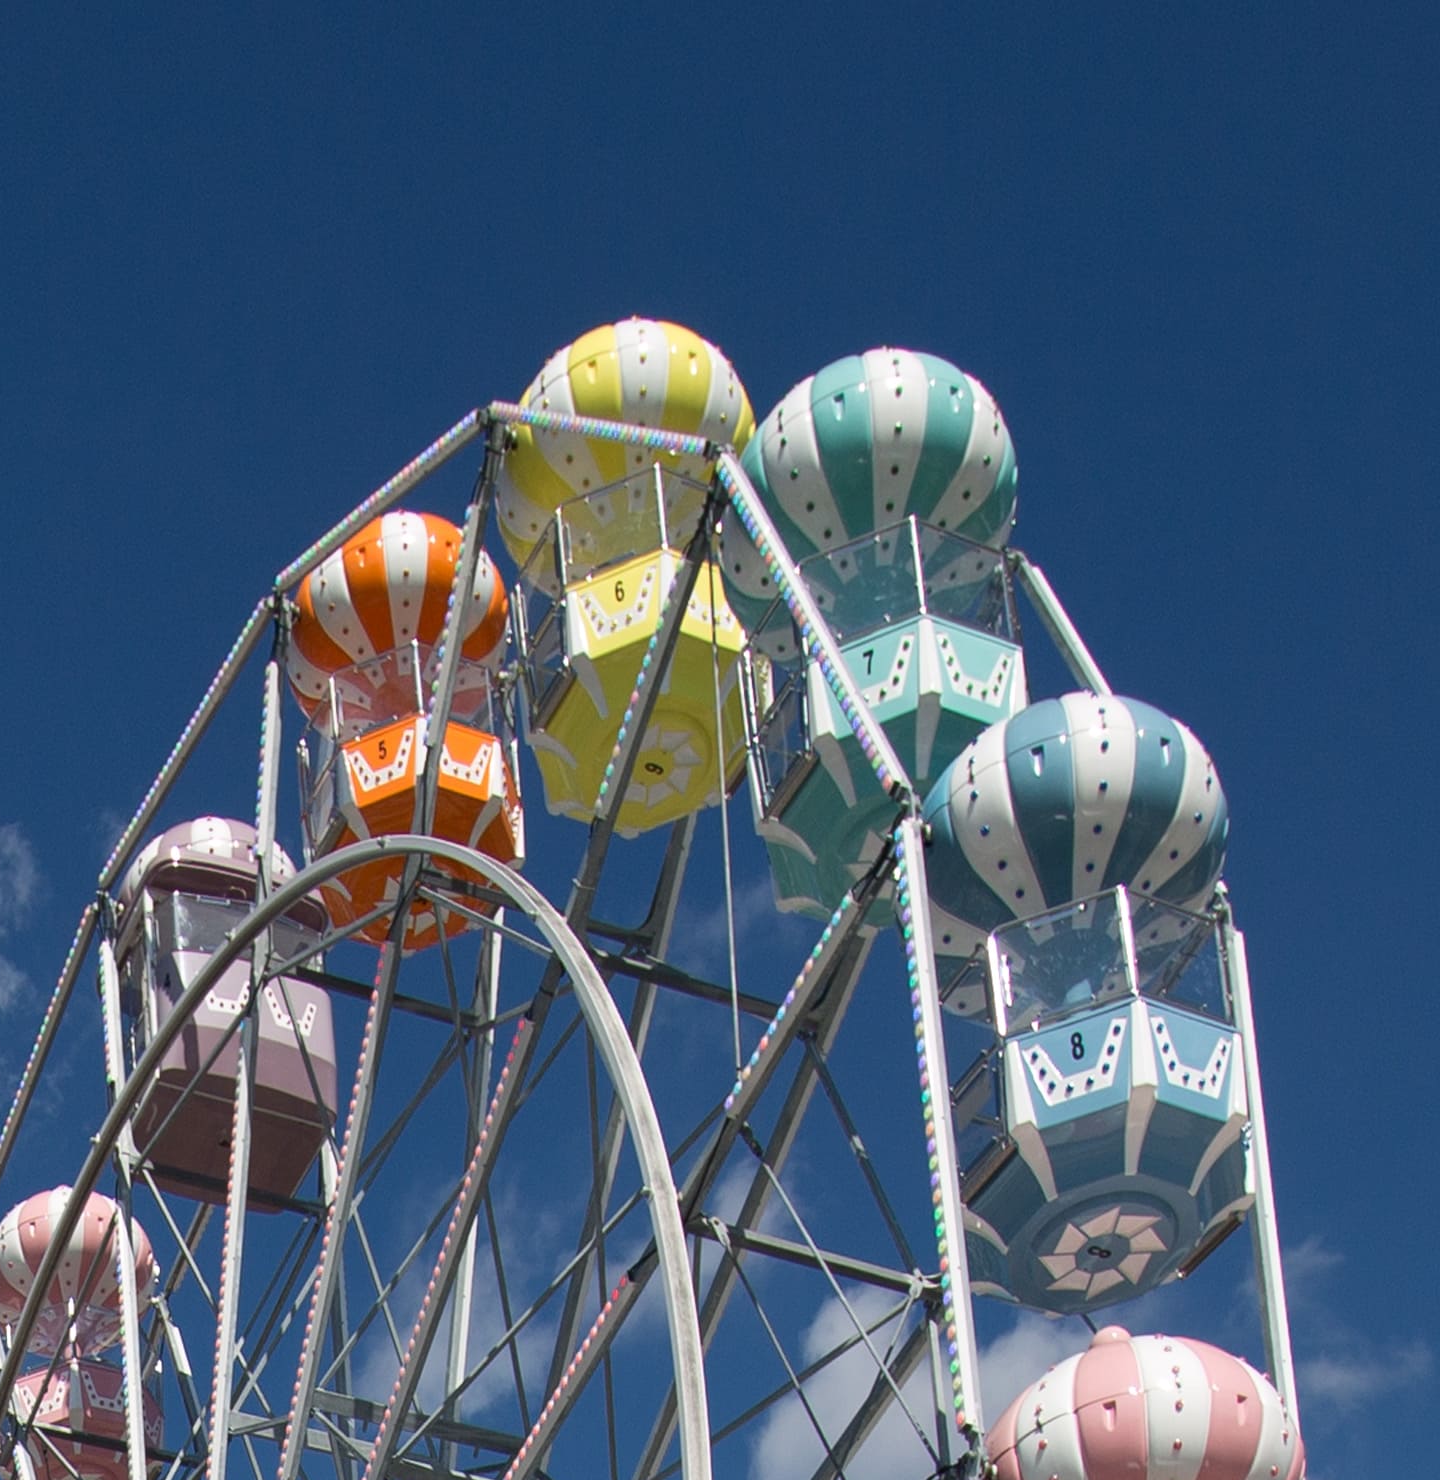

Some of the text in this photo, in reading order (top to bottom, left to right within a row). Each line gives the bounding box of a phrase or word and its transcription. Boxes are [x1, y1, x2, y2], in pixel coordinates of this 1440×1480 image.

[614, 580, 625, 602] 6
[862, 648, 874, 675] 7
[377, 740, 388, 760] 5
[1069, 1032, 1085, 1060] 8
[1087, 1245, 1112, 1259] 8
